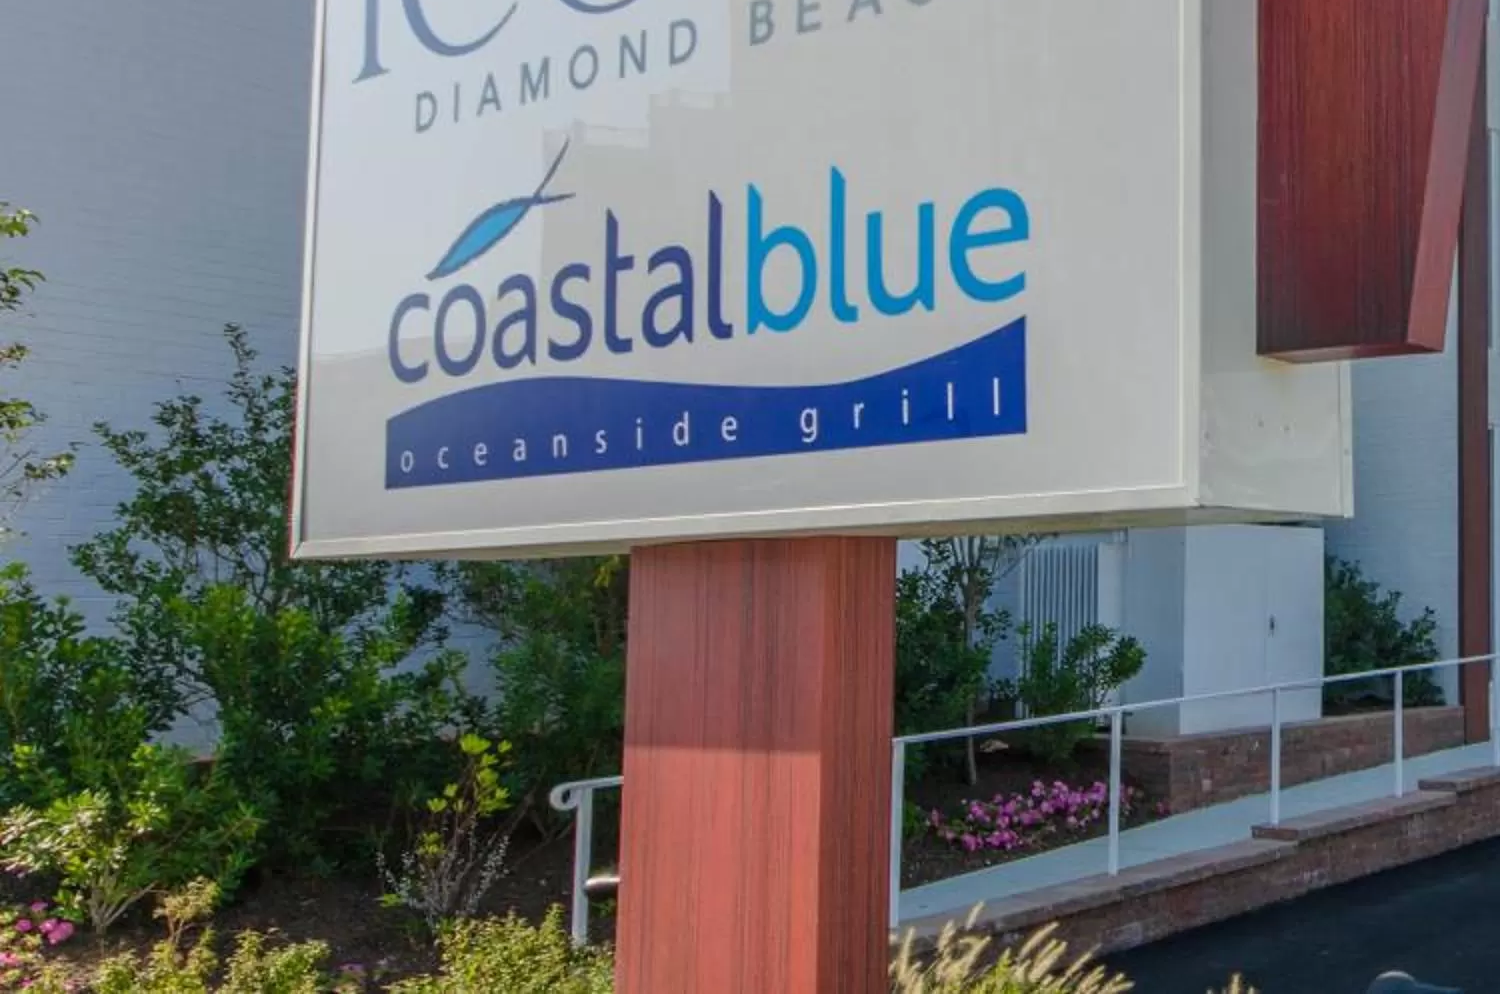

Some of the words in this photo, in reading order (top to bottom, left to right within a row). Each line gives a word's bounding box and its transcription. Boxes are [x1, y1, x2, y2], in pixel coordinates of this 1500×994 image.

[415, 18, 699, 133] DIAMOND
[400, 411, 738, 473] oceanside
[800, 377, 1001, 442] grill
